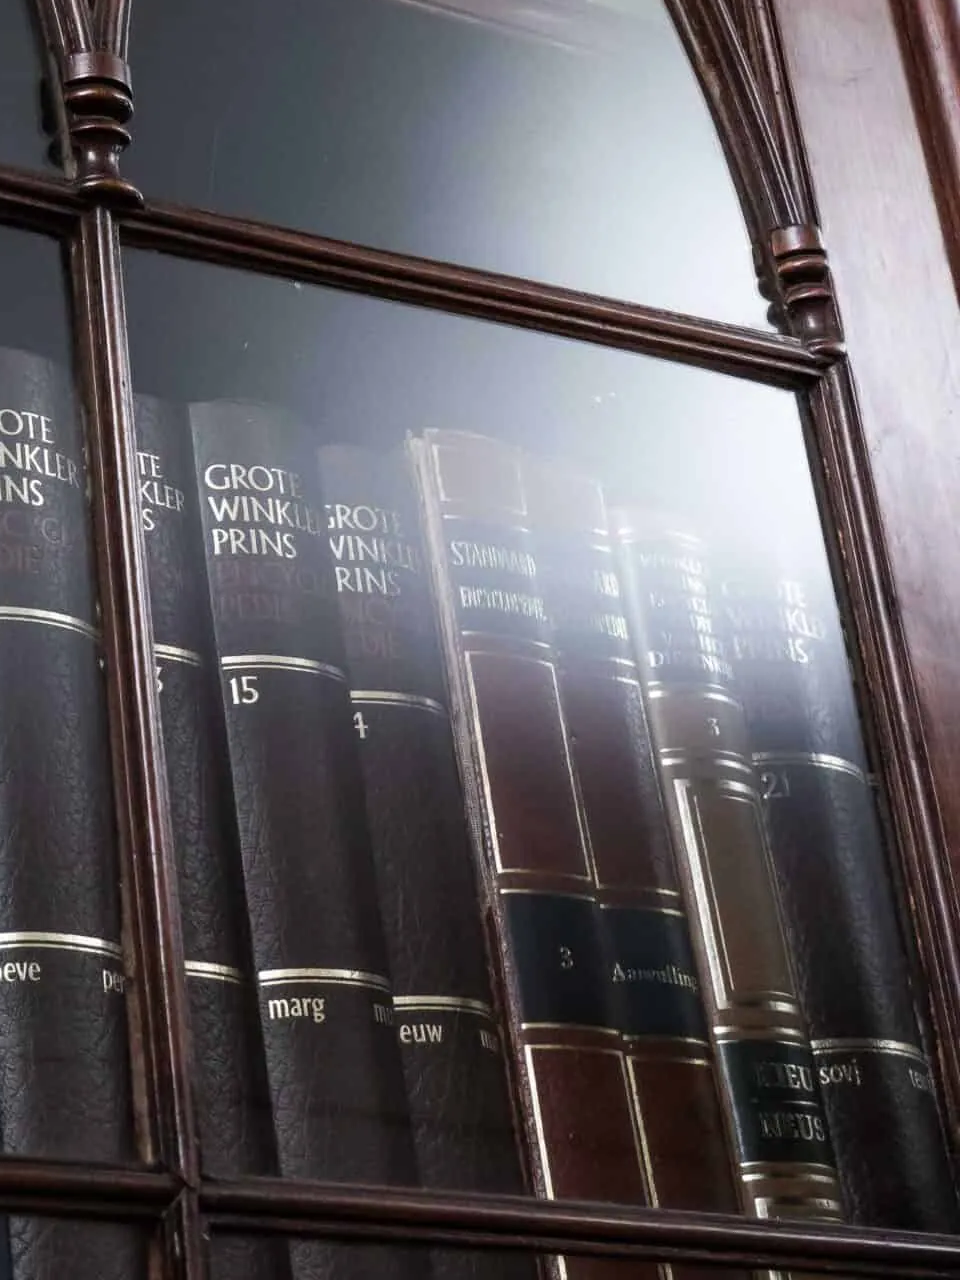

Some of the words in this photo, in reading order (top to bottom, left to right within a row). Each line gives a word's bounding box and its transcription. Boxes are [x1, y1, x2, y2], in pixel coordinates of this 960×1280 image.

[204, 463, 303, 499] GROTE
[211, 528, 297, 559] PRINS
[229, 675, 260, 706] 15
[559, 945, 574, 969] 3
[268, 996, 326, 1023] marg
[819, 1058, 862, 1087] sovj
